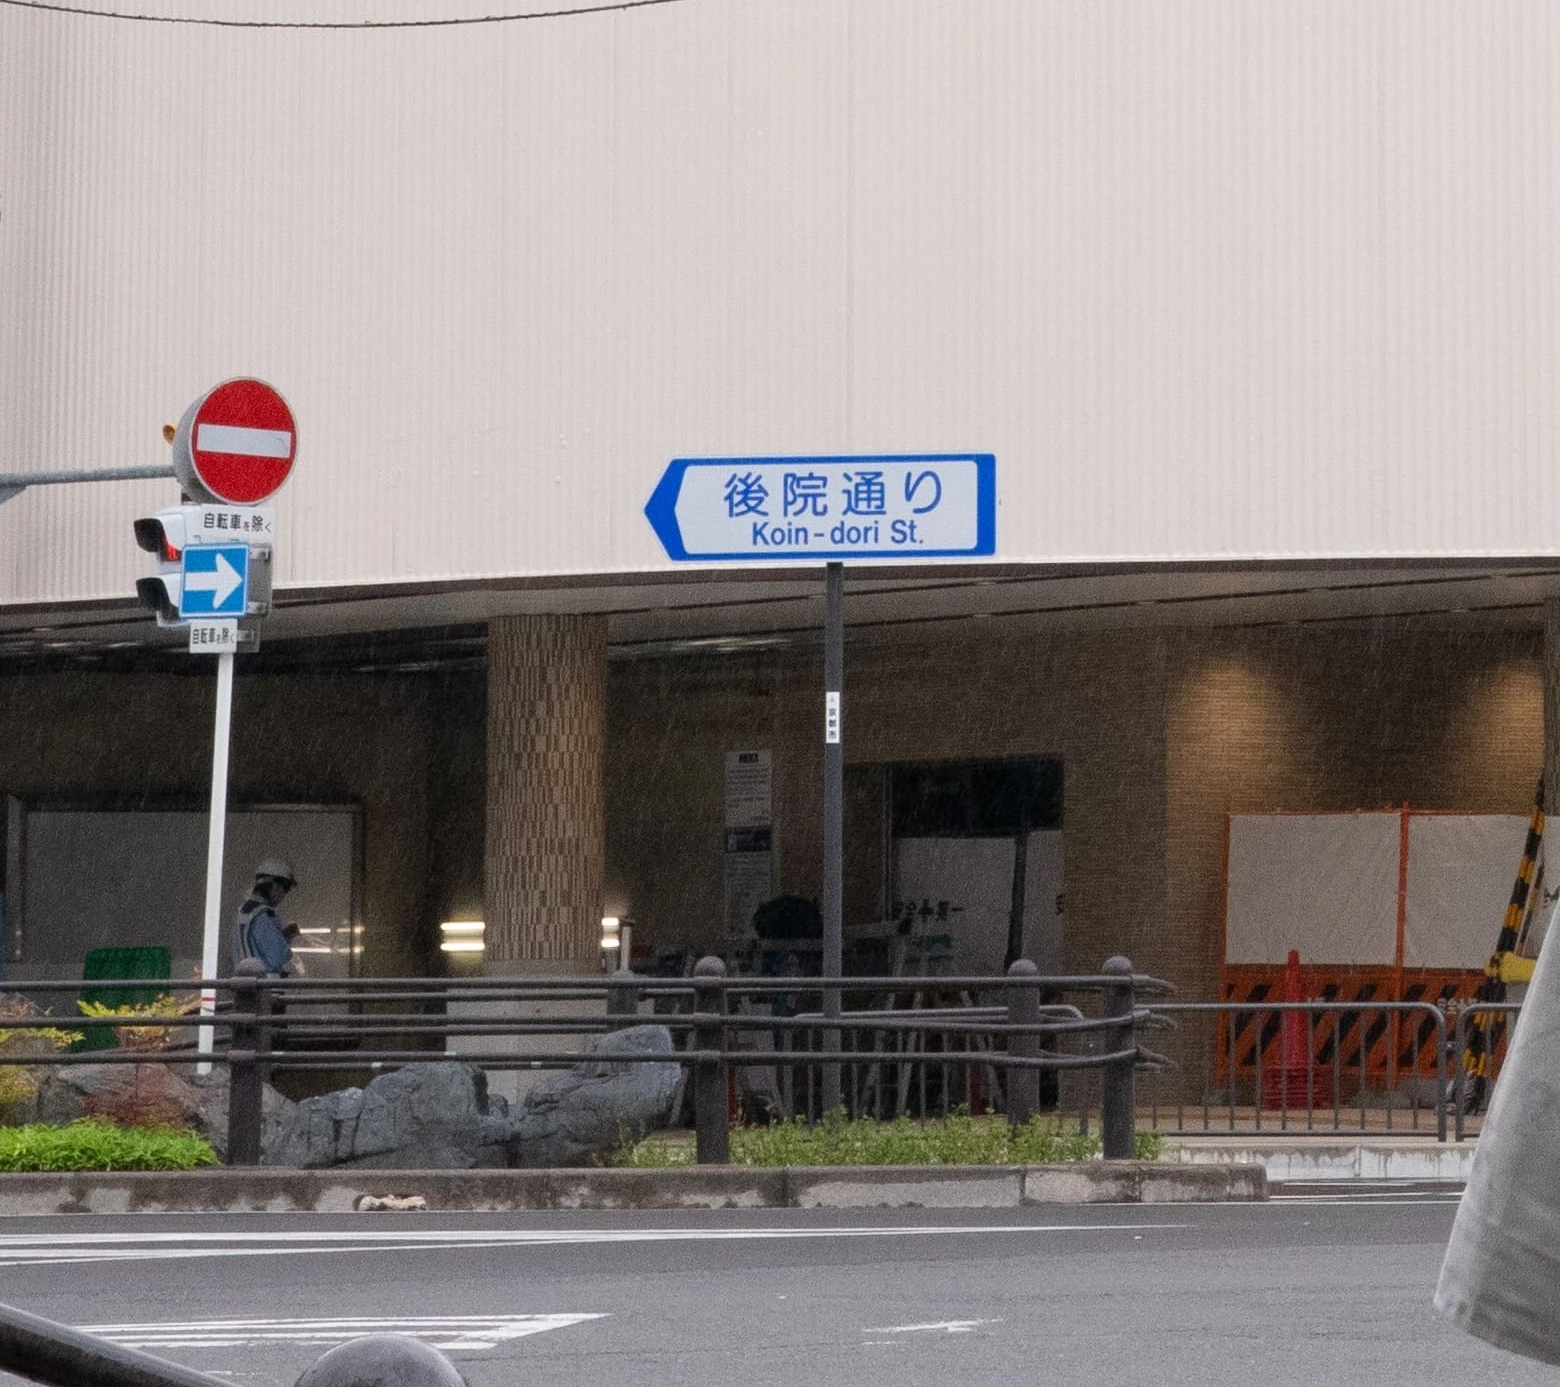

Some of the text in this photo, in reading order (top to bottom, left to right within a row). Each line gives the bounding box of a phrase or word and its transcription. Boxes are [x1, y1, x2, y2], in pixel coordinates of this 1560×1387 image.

[723, 470, 943, 519] 後院通り
[204, 513, 272, 533] 自転車を除く
[752, 519, 925, 546] Koin-dori St.
